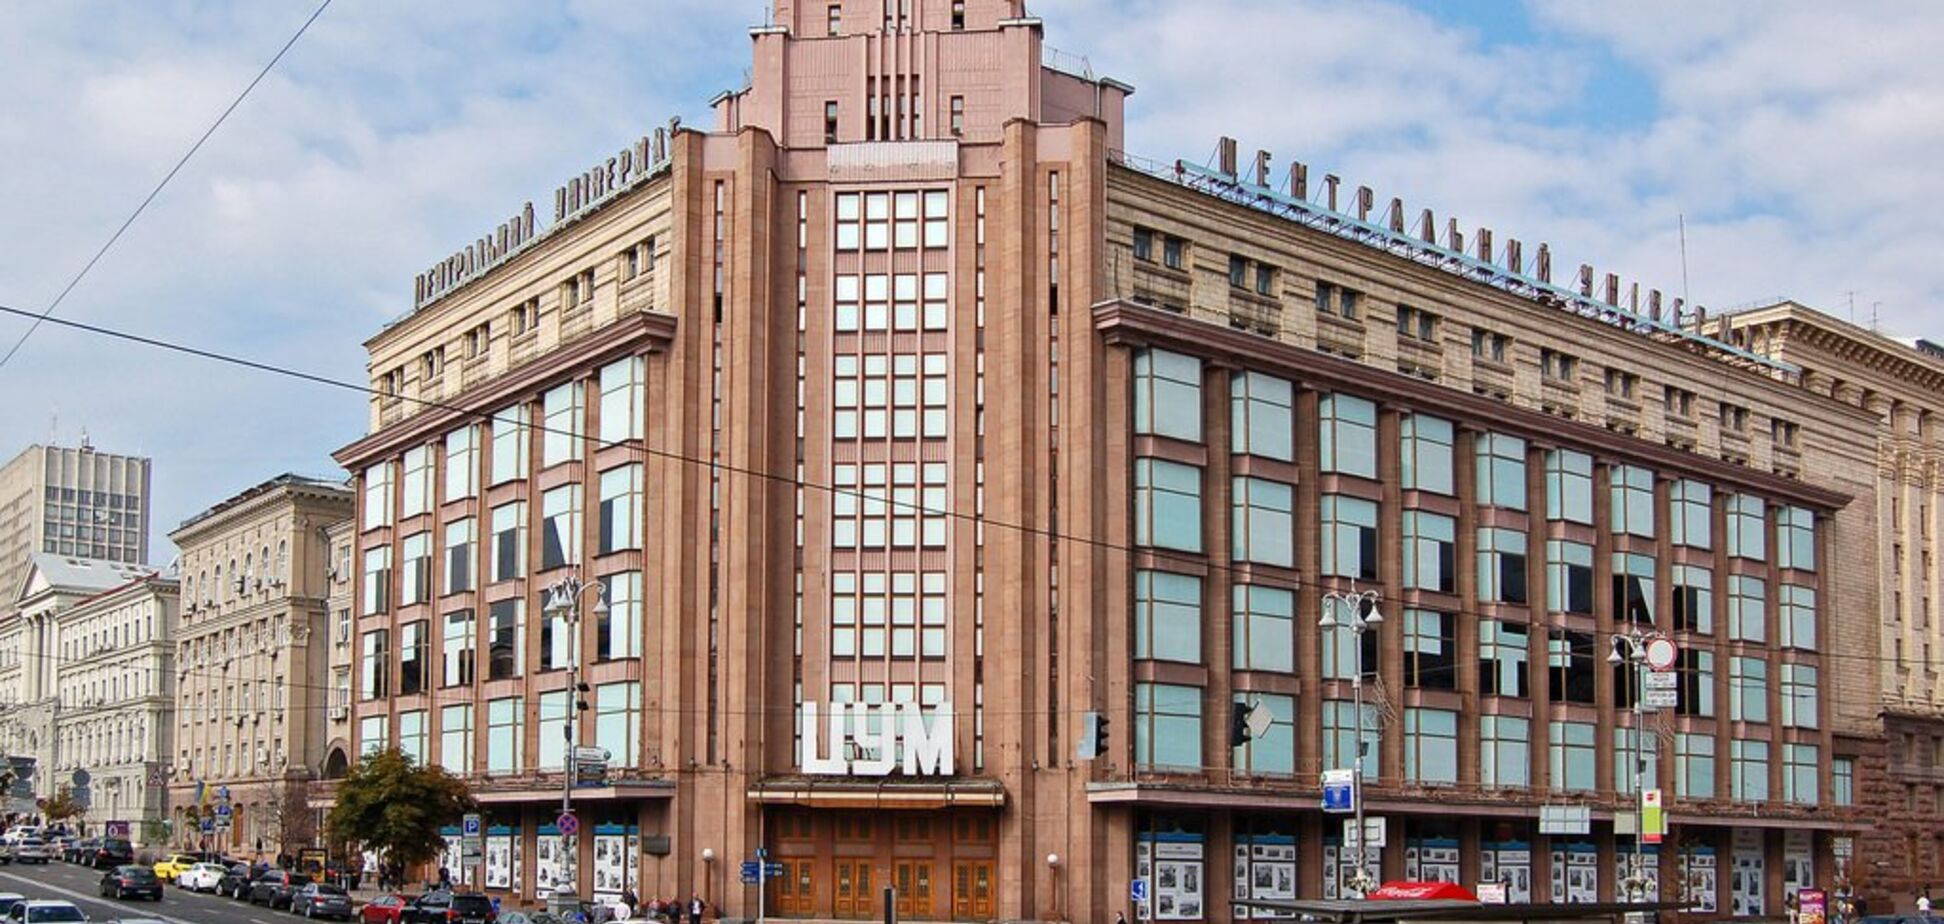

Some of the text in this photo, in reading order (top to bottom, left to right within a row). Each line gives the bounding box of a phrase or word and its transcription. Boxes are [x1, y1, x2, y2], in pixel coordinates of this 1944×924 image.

[415, 201, 534, 310] ЦЕНТРАЛЬНИЙ
[1219, 136, 1551, 284] ЦЕНТРАЛЬНИЙ
[802, 701, 954, 776] ЦУМ
